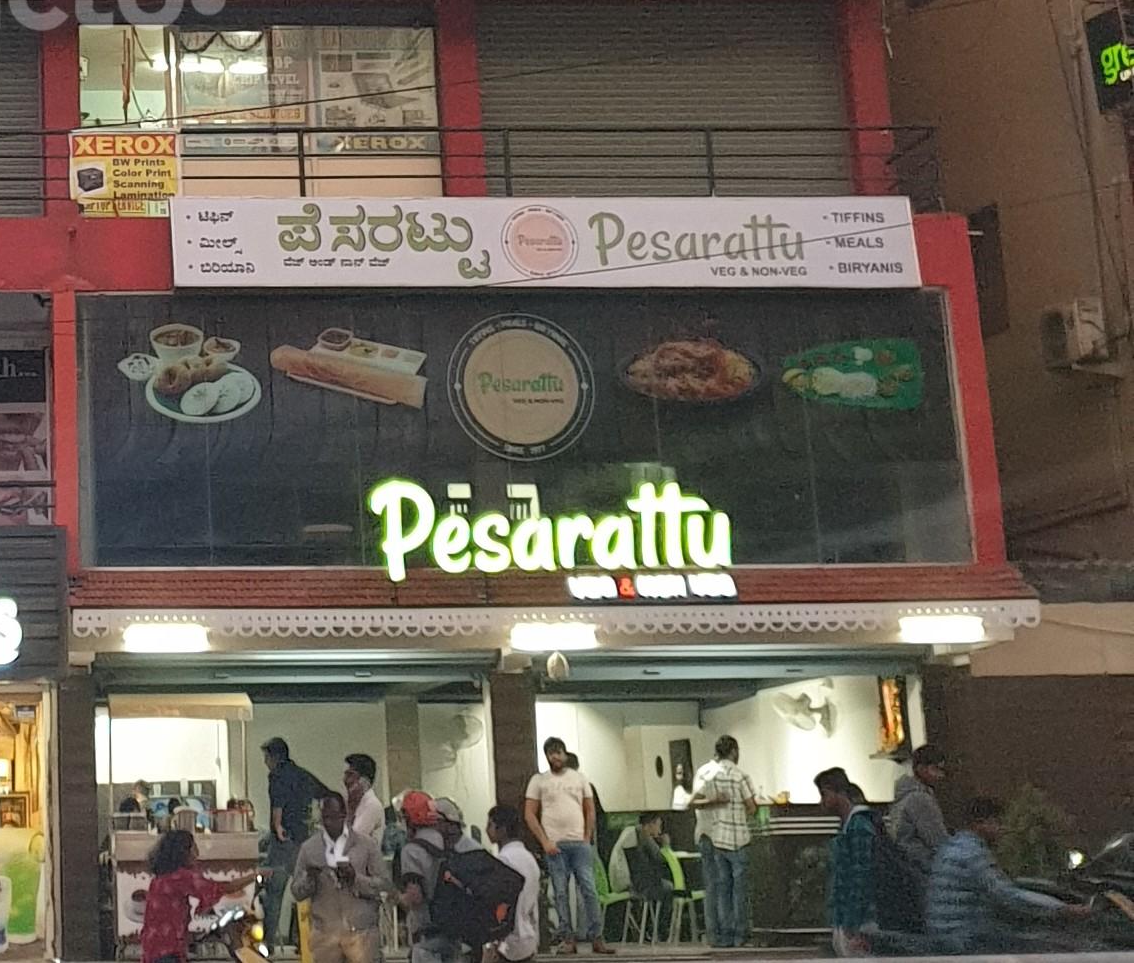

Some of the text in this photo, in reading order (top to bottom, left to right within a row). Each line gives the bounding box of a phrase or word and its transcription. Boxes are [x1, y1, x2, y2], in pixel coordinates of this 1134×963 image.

[73, 135, 176, 156] XEROX
[335, 135, 427, 151] XEROX
[112, 158, 166, 167] BW Prints
[112, 168, 172, 178] Color Print
[113, 179, 165, 190] Scanning
[113, 190, 176, 200] Lamination
[831, 211, 886, 224] TIFFINS
[587, 211, 807, 267] Pesarattu
[834, 236, 885, 249] MEALS
[710, 265, 808, 277] VEG & NON-VEG
[838, 262, 904, 274] BIRYANIS
[478, 371, 564, 395] Pesarattu
[370, 478, 734, 582] Pesarattu
